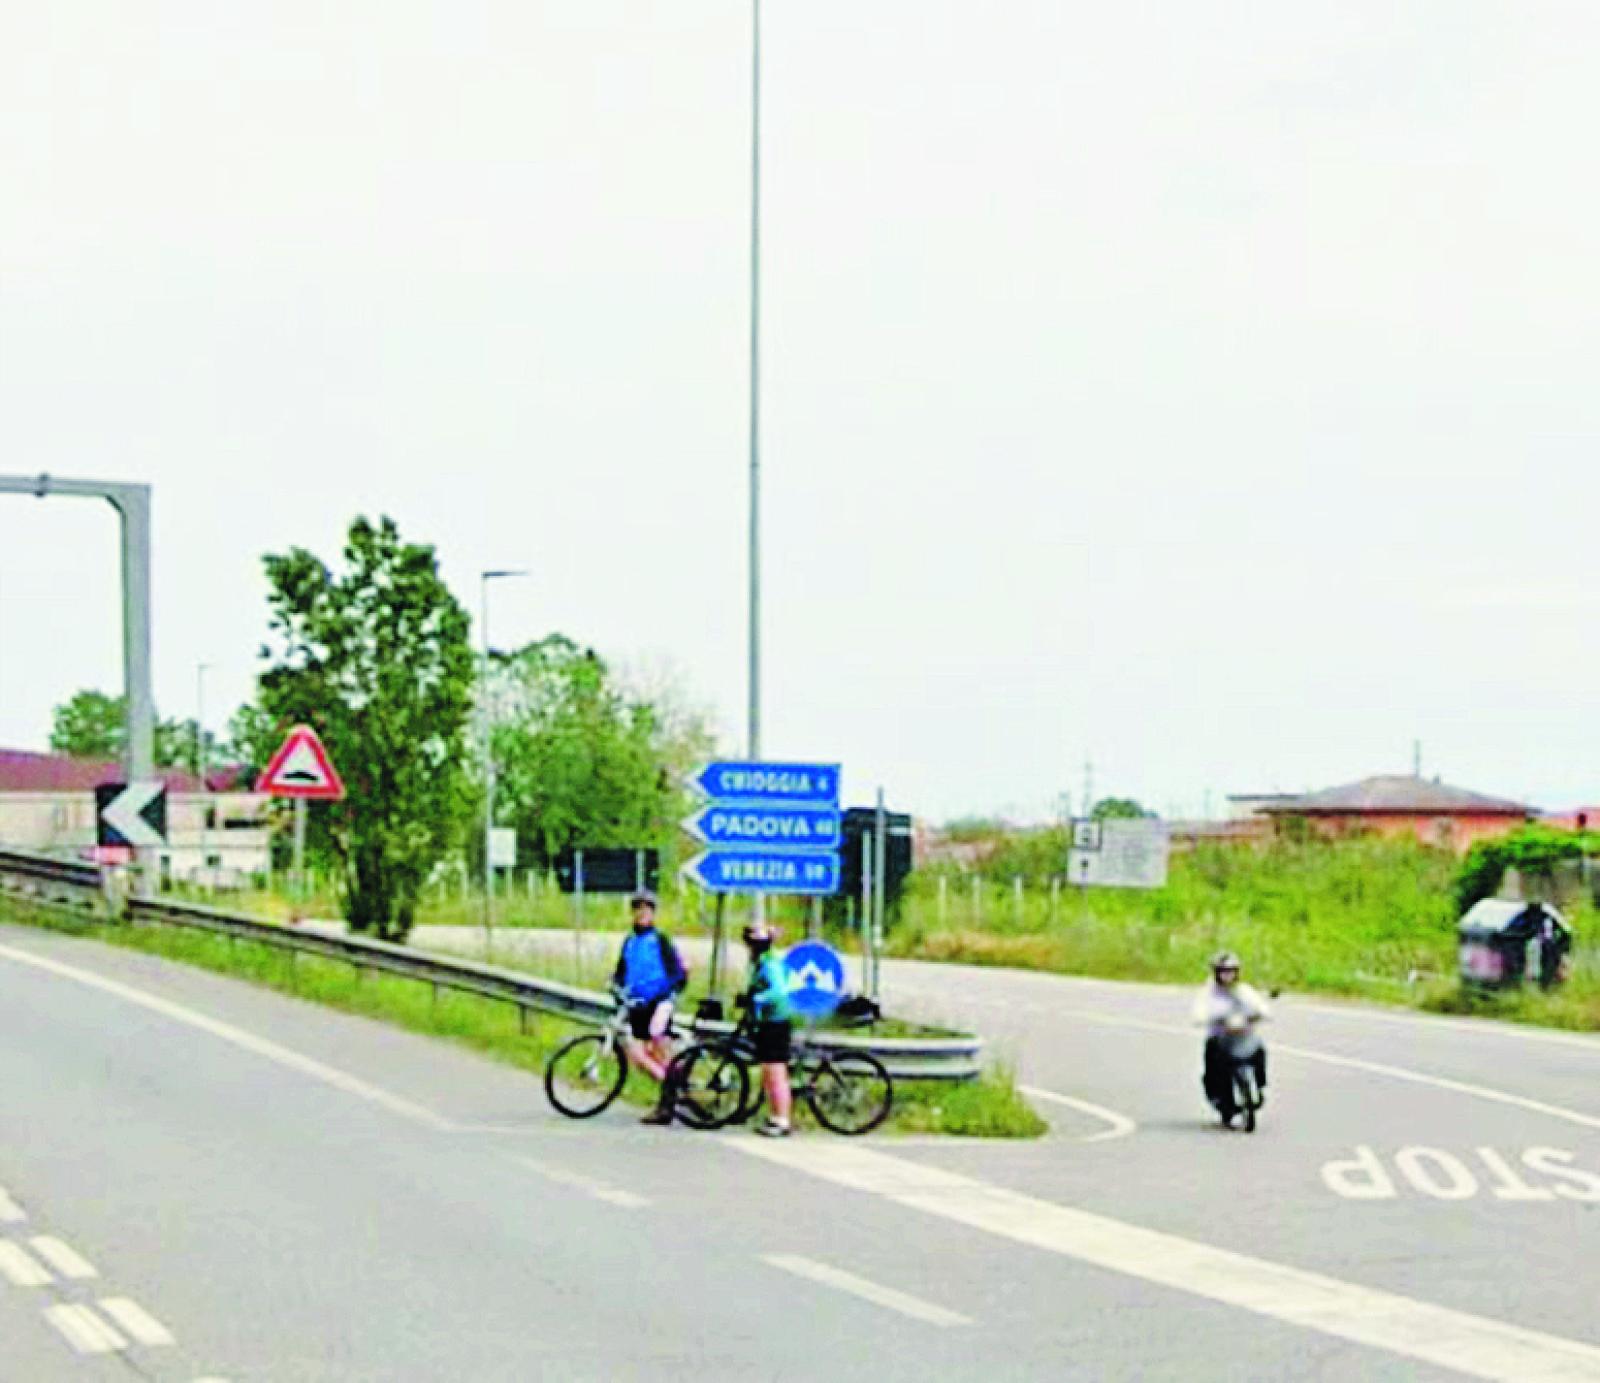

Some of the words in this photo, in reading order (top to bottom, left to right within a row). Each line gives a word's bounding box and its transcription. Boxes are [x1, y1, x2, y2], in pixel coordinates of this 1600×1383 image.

[711, 814, 810, 837] PADOVA
[720, 860, 796, 880] VENEZIA
[1319, 1144, 1600, 1200] STOP
